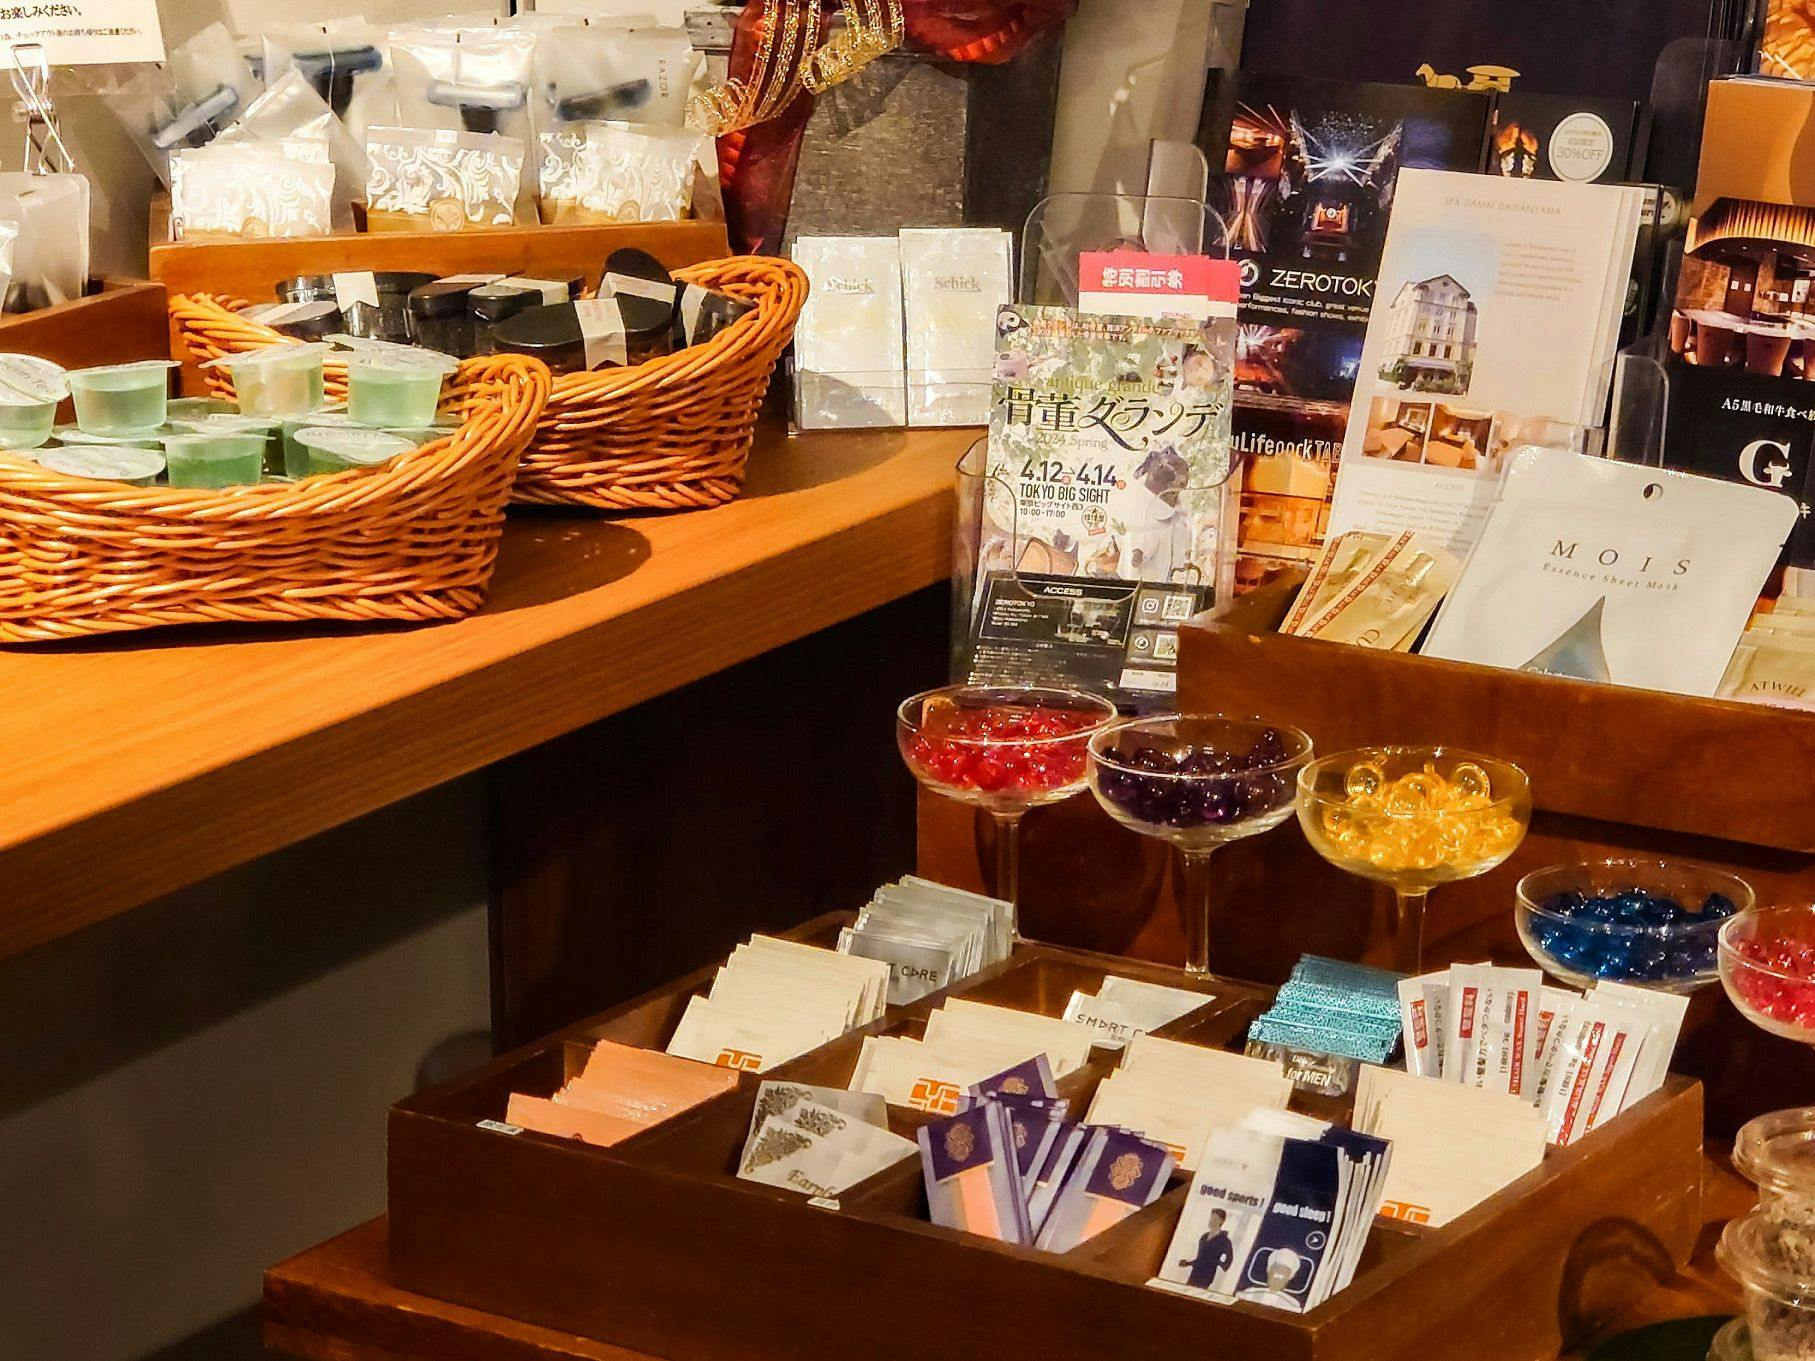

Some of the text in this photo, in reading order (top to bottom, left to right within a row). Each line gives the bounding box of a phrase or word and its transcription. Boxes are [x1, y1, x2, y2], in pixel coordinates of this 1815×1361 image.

[658, 59, 669, 98] RAZOR
[933, 276, 982, 291] Schick
[1101, 266, 1184, 290] 特別割引券
[1270, 269, 1377, 297] ZEROTOK
[1036, 431, 1108, 449] 2024 Spring
[1020, 483, 1111, 504] TOKYO BIG SIGHT
[1542, 562, 1596, 581] Essence
[1602, 574, 1640, 588] Sheet
[1043, 586, 1083, 596] ACCESS
[1200, 1183, 1226, 1200] good
[1272, 1201, 1299, 1217] good
